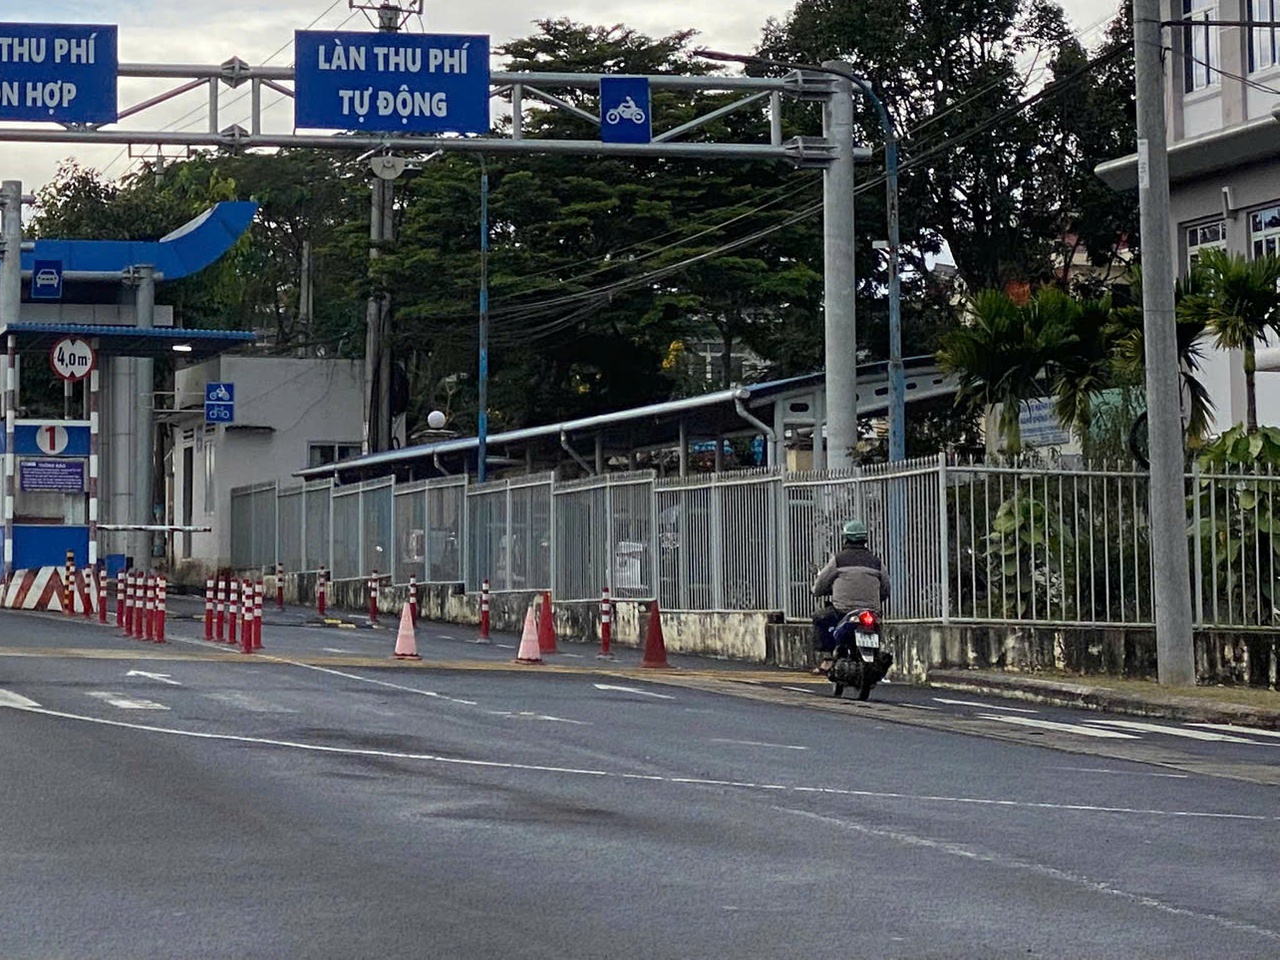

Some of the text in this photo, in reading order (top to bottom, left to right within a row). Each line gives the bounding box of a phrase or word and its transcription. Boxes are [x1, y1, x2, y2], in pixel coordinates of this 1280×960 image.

[54, 33, 98, 64] PHÍ
[318, 38, 468, 74] LÀN THU PHÍ
[26, 80, 77, 115] HỢP
[339, 84, 447, 125] TỰ ĐỘNG
[45, 426, 56, 451] 1
